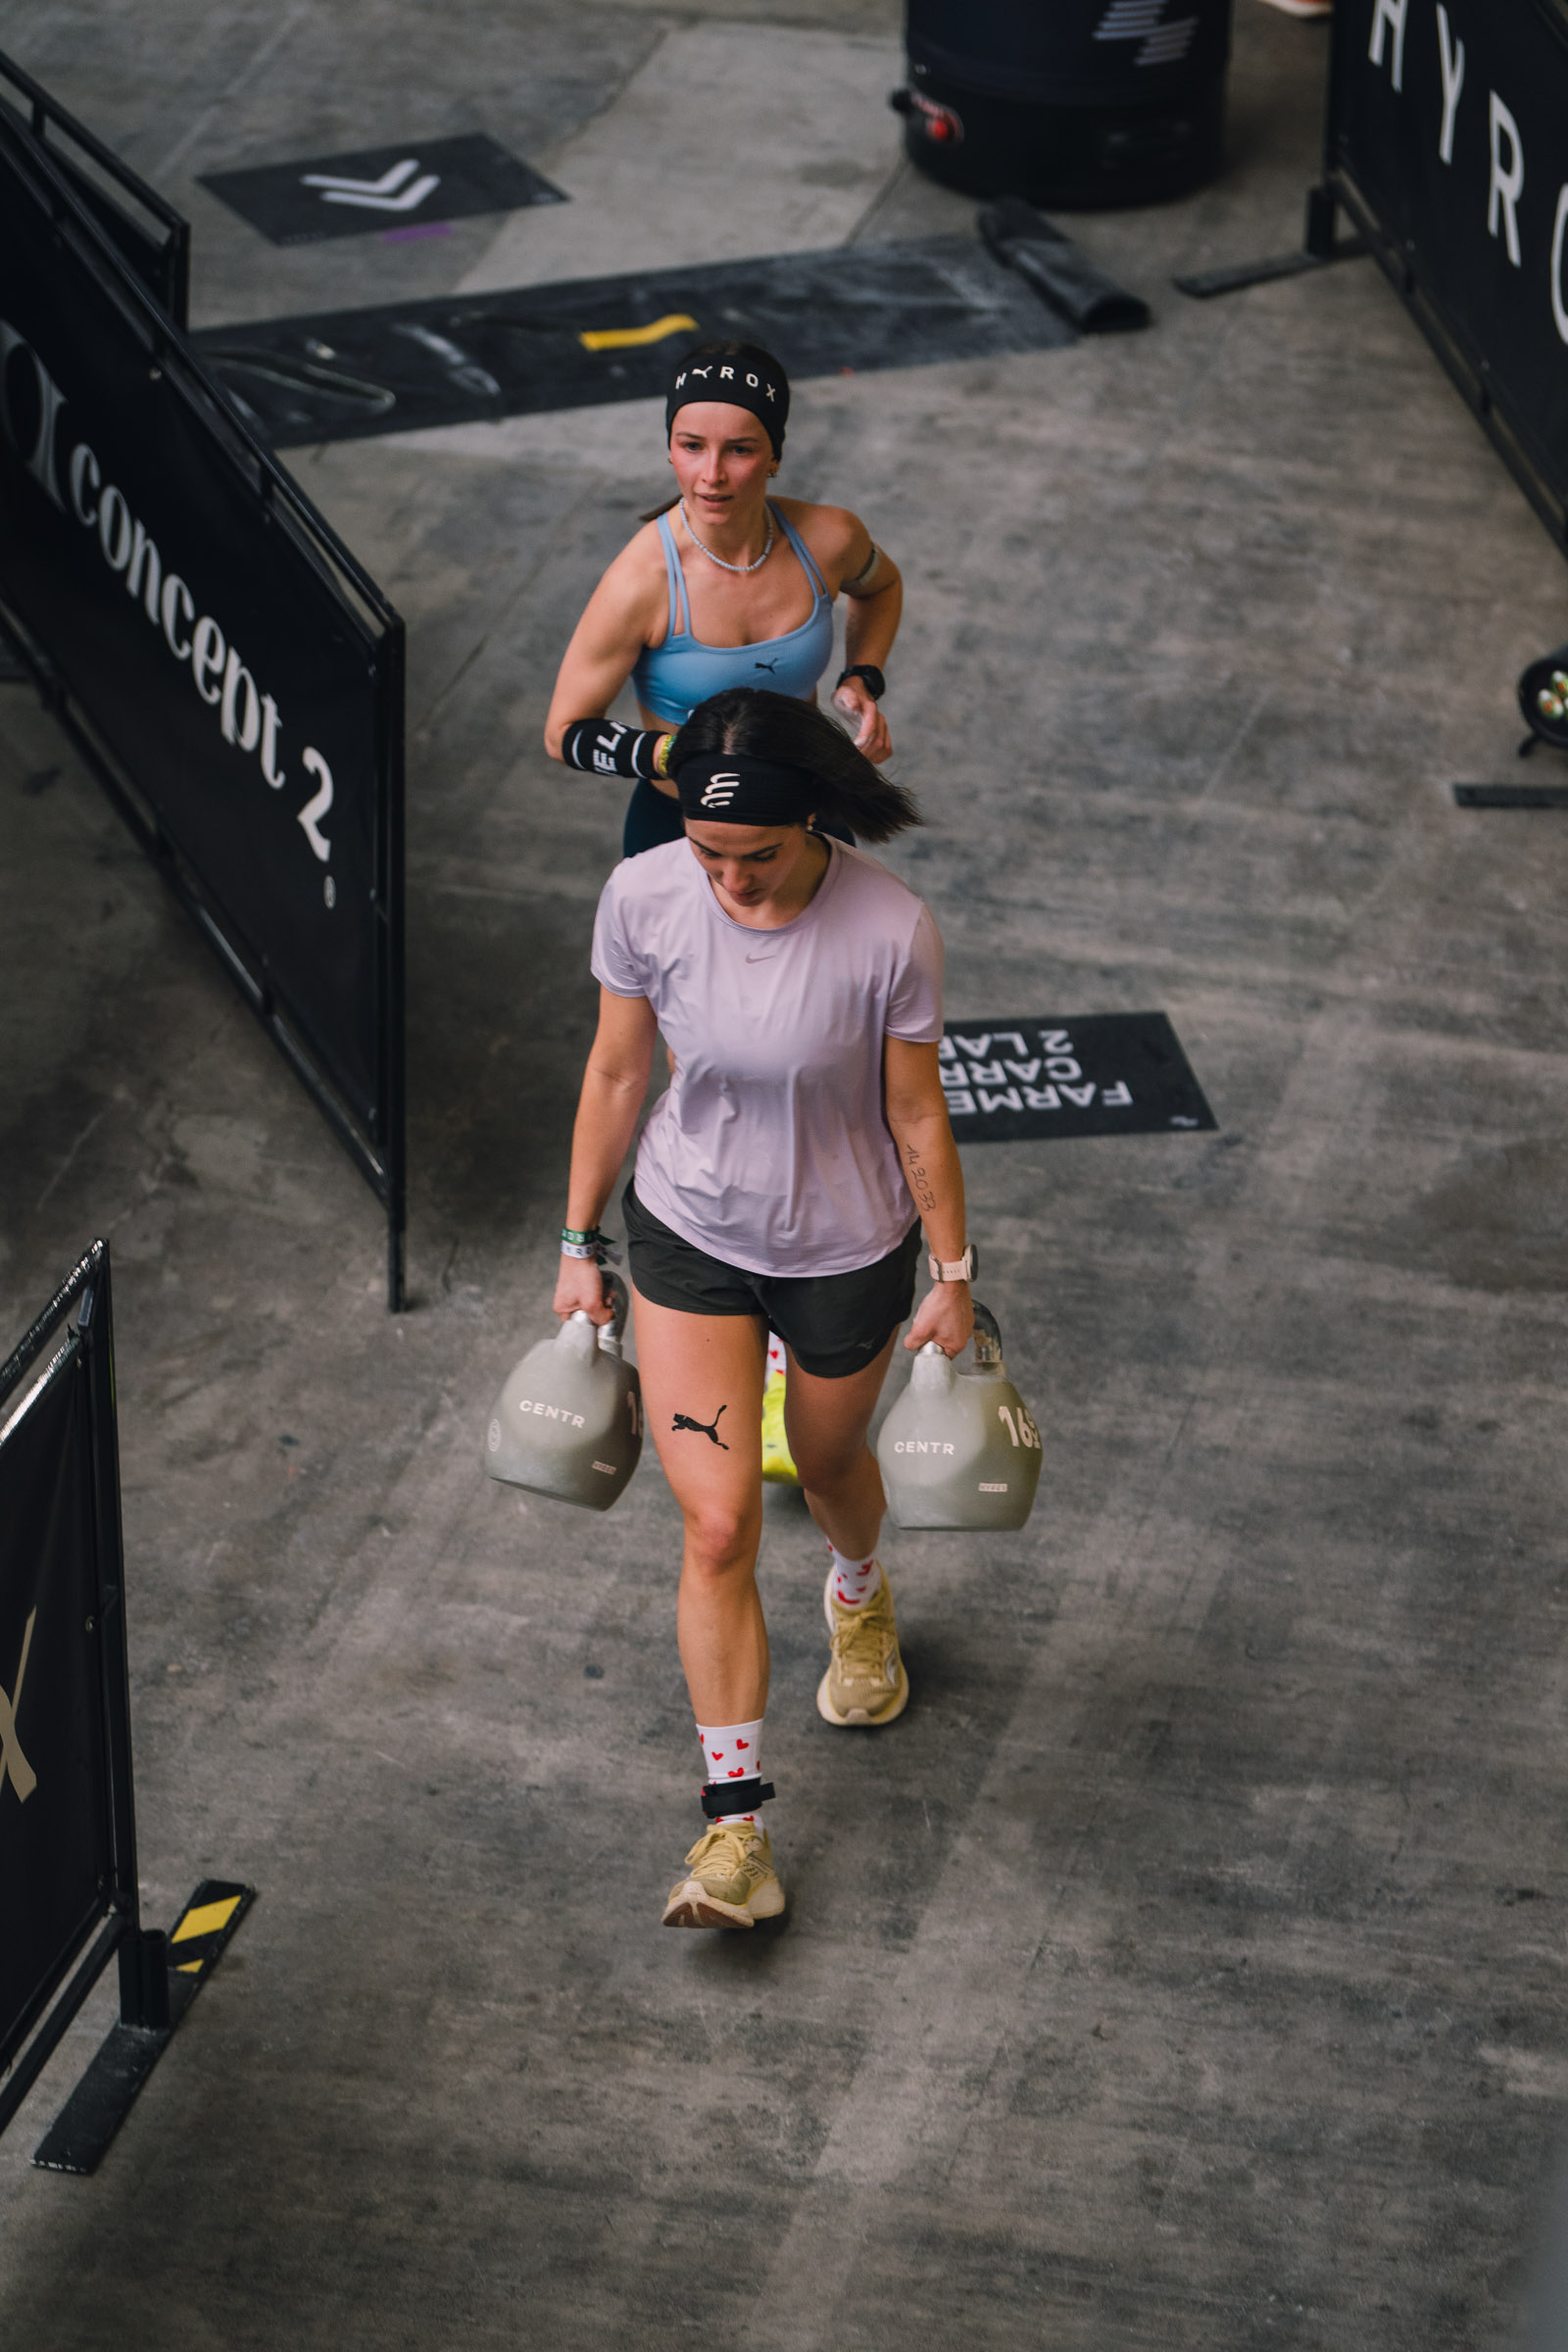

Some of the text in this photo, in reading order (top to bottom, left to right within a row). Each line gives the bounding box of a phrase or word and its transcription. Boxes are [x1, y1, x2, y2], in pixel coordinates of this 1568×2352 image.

[675, 366, 776, 403] HYROX
[71, 444, 286, 790] concept
[1038, 1029, 1074, 1054] 2
[940, 1055, 1083, 1088] CARR
[945, 1080, 1134, 1115] FARME
[519, 1399, 586, 1429] CENTR
[894, 1441, 956, 1456] CENTR
